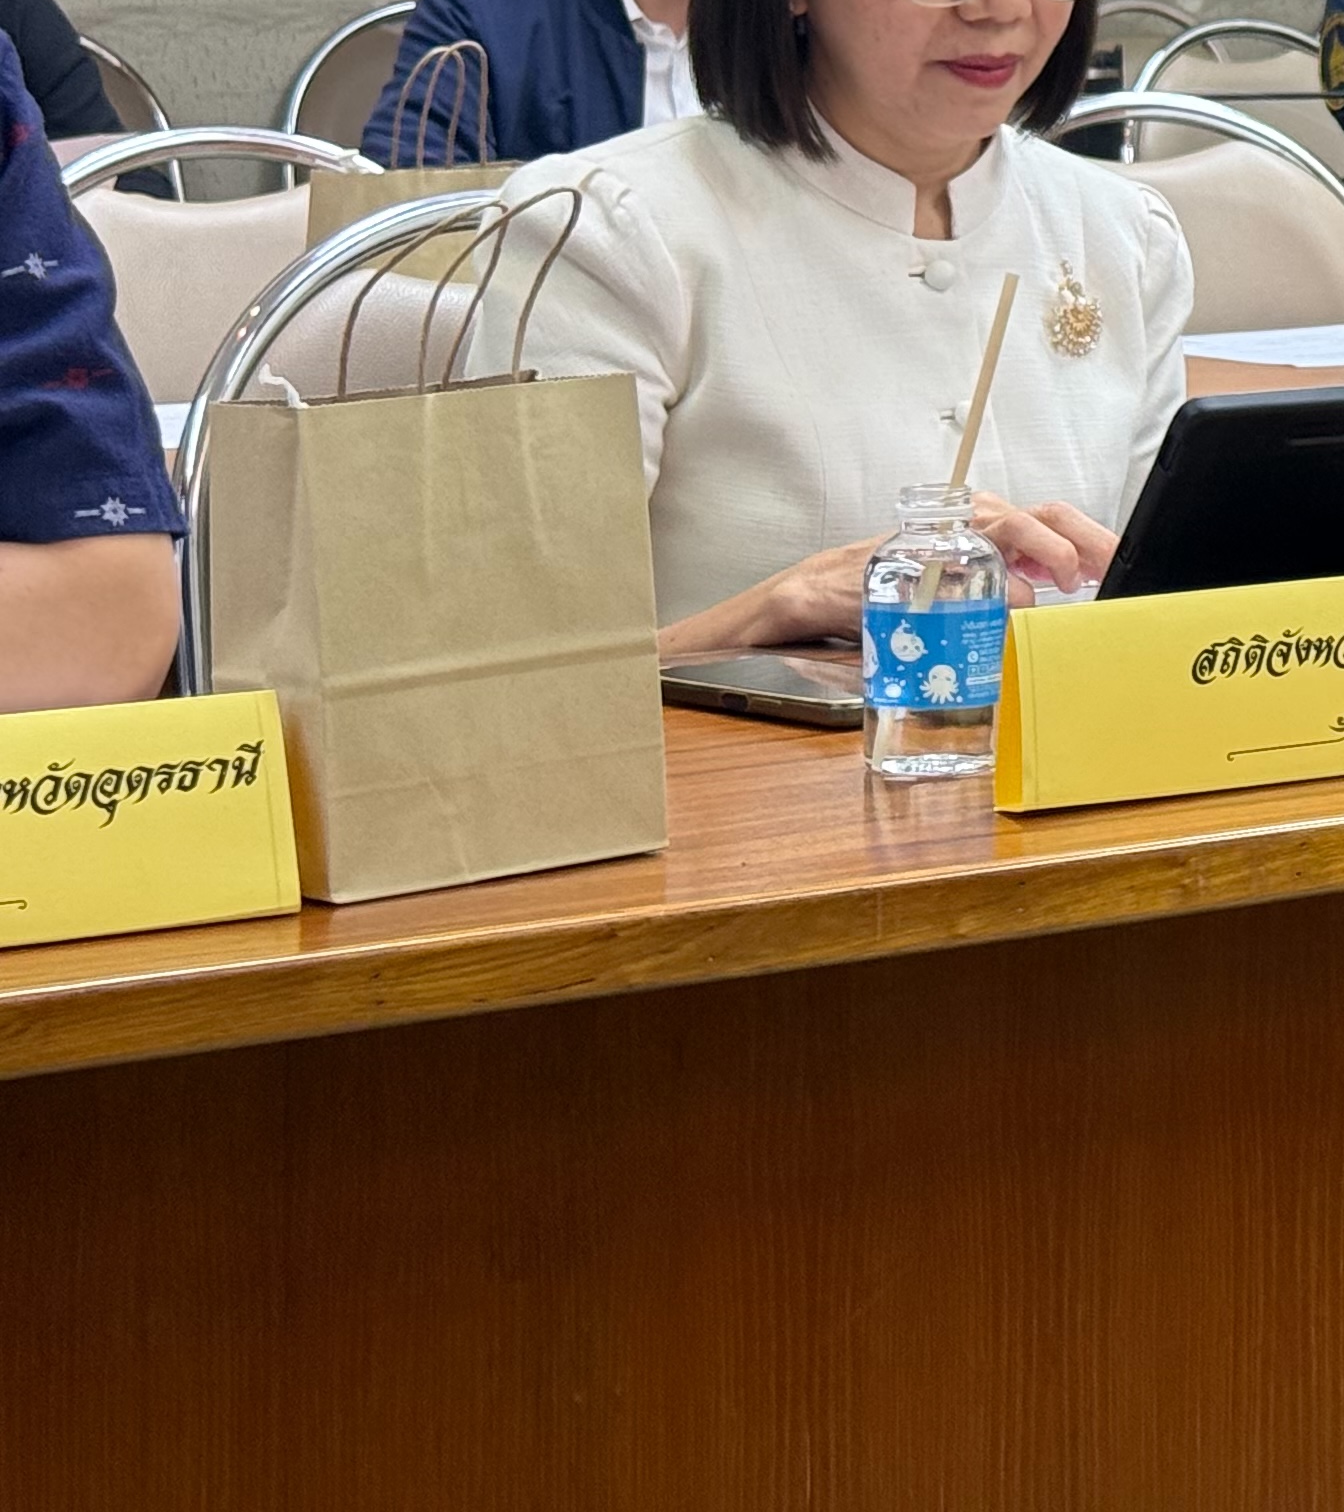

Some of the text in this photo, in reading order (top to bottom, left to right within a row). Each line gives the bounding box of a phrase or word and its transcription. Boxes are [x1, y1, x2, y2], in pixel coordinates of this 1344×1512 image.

[0, 739, 264, 829] หวัดอุดรธานี
